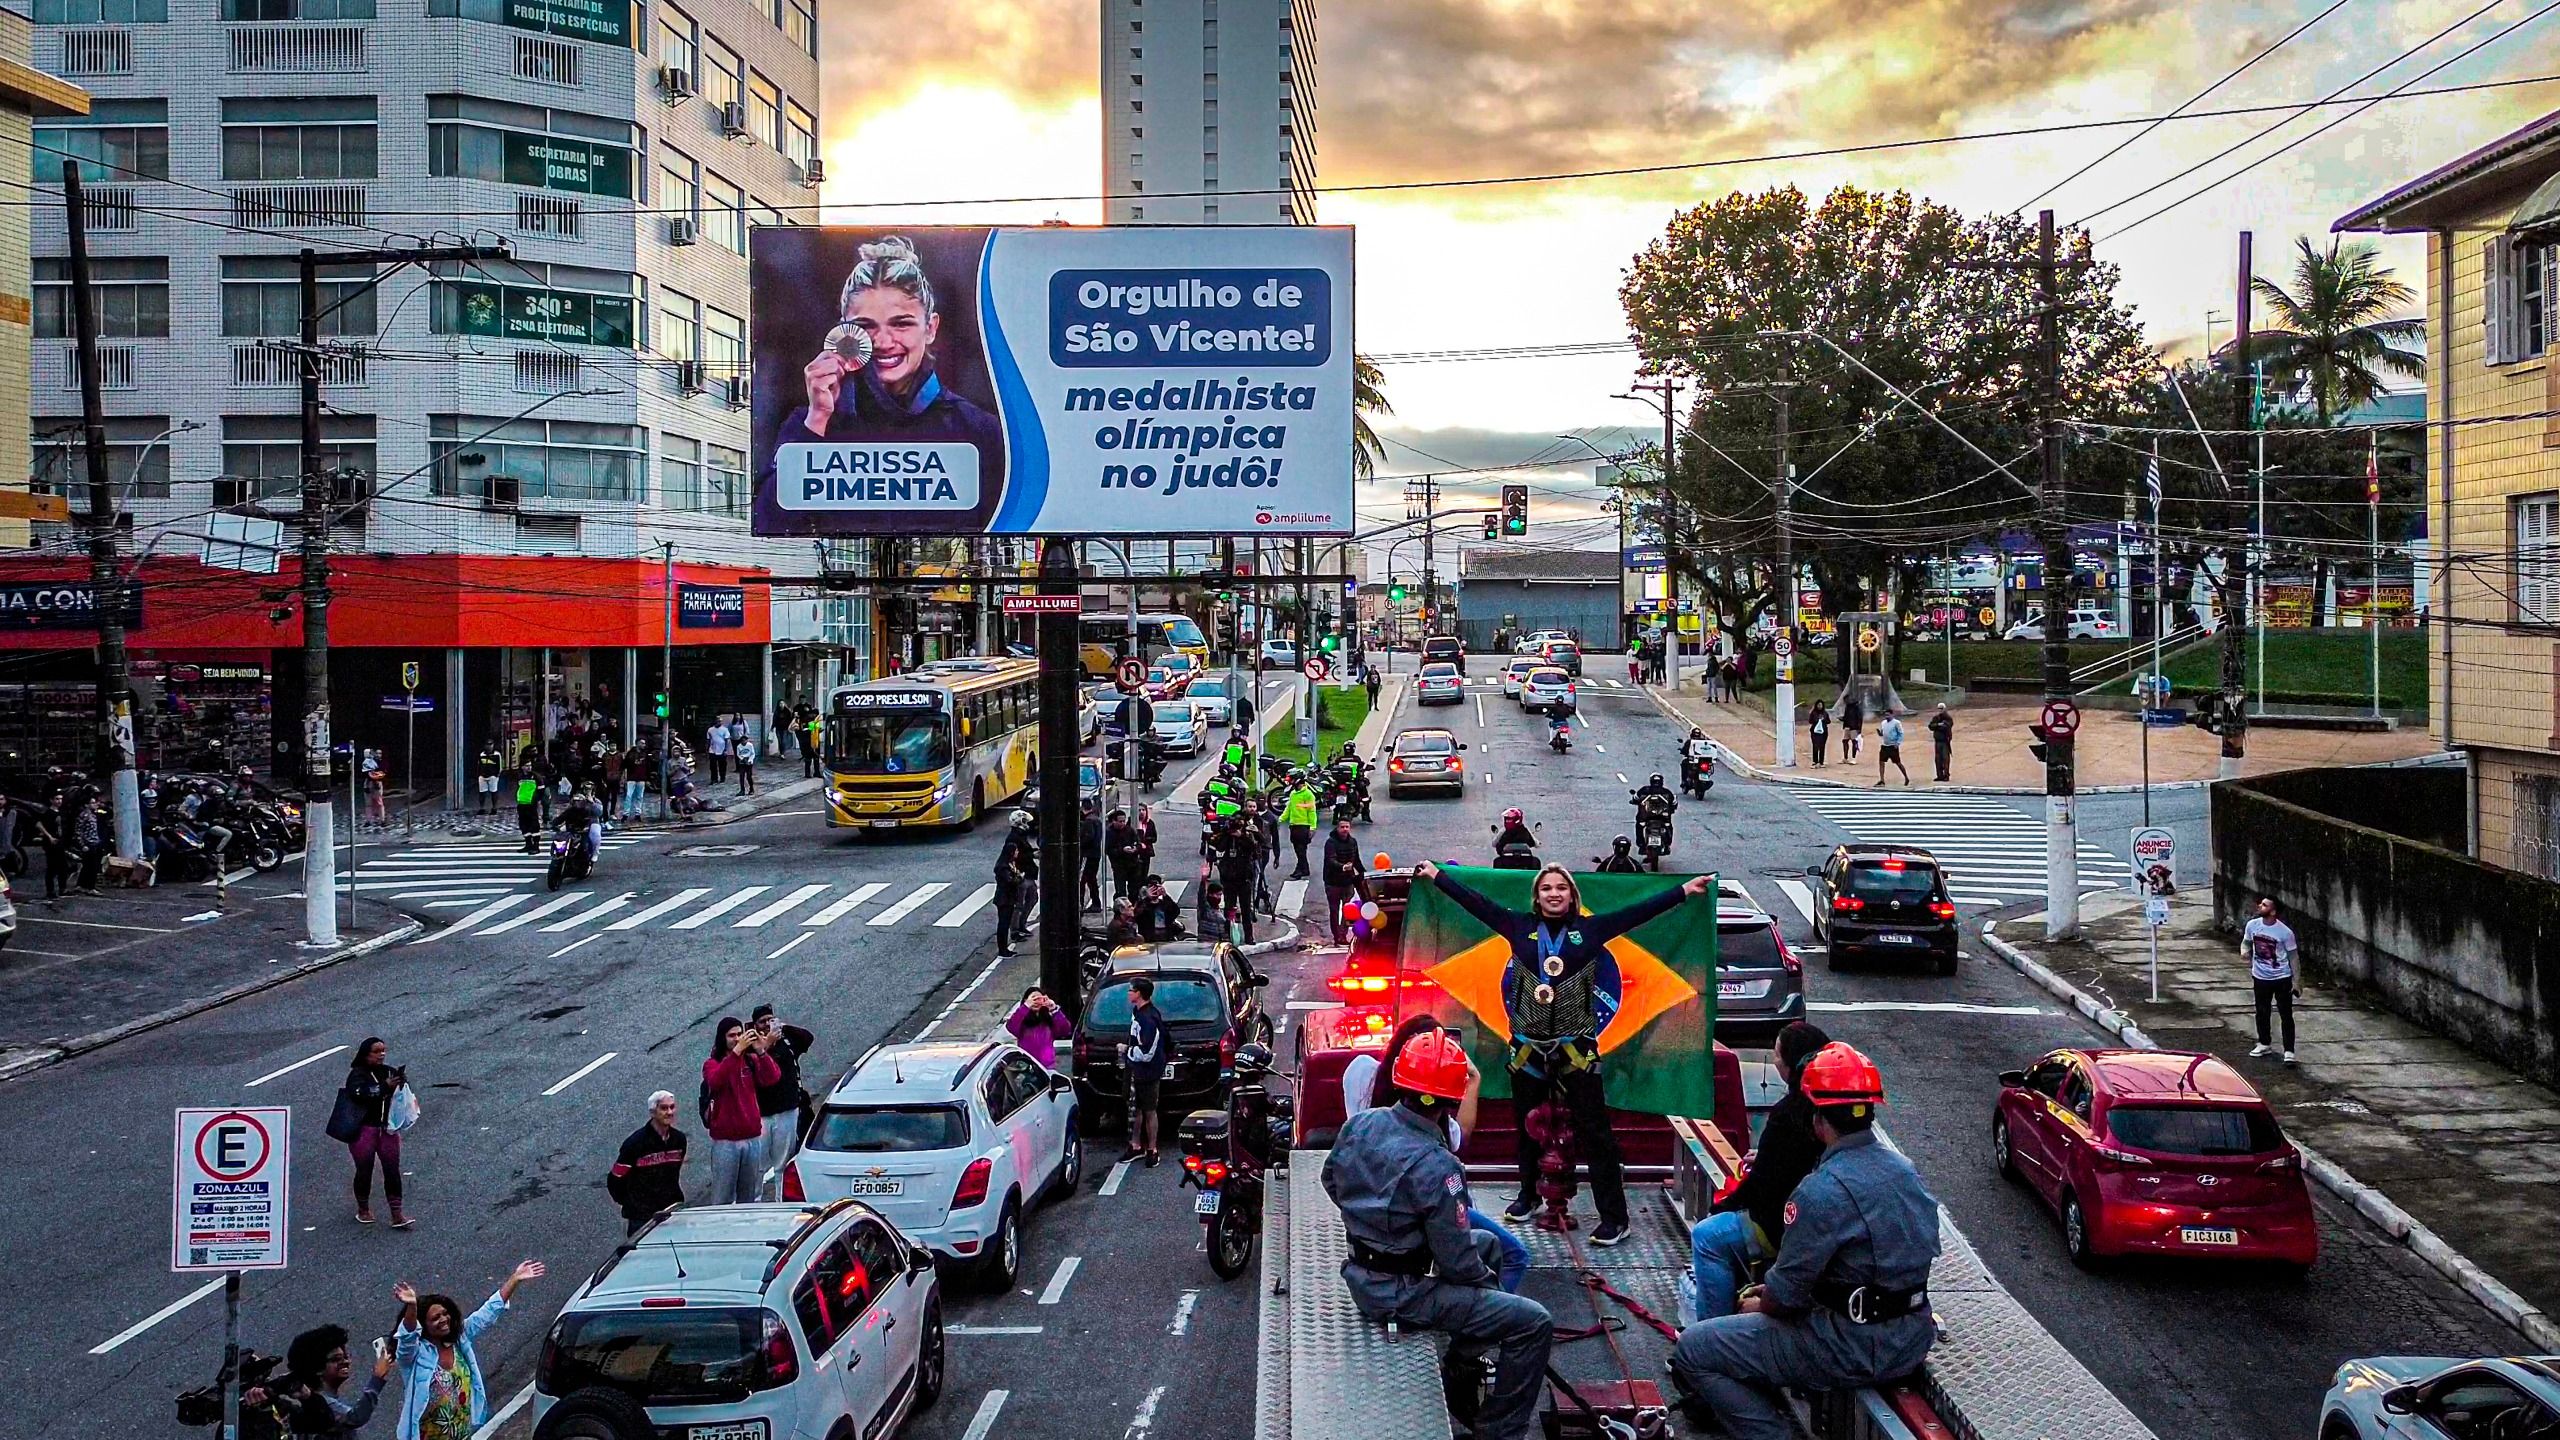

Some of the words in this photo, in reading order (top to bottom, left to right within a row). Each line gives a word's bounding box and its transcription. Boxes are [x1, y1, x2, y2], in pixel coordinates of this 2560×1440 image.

[591, 2, 604, 14] DE
[513, 4, 567, 25] PROJETOS
[568, 14, 620, 36] ESPECIAIS
[528, 145, 587, 164] SECRETARIA
[593, 155, 605, 166] DE
[548, 164, 588, 182] OBRAS
[1078, 279, 1242, 315] Orgulho
[1252, 278, 1303, 308] de
[510, 319, 536, 332] ZONA
[537, 320, 587, 337] ELEITORAL
[1064, 322, 1139, 352] São
[1148, 320, 1316, 352] Vicente!
[1064, 376, 1317, 411] medalhista
[1095, 414, 1287, 457] olímpica
[806, 451, 946, 474] LARISSA
[1100, 464, 1157, 488] no
[1162, 453, 1283, 496] judô!
[802, 477, 958, 501] PIMENTA
[1274, 512, 1331, 524] amplilume
[684, 592, 712, 610] FARMA
[714, 594, 742, 610] CONDE
[1006, 599, 1078, 608] AMPLILUME
[1777, 642, 1789, 650] 50
[203, 668, 220, 678] SEJA
[846, 695, 875, 705] 202P
[2136, 840, 2172, 848] ANUNCIE
[217, 1126, 247, 1169] E
[198, 1184, 231, 1194] ZONA
[233, 1183, 264, 1193] AZUL
